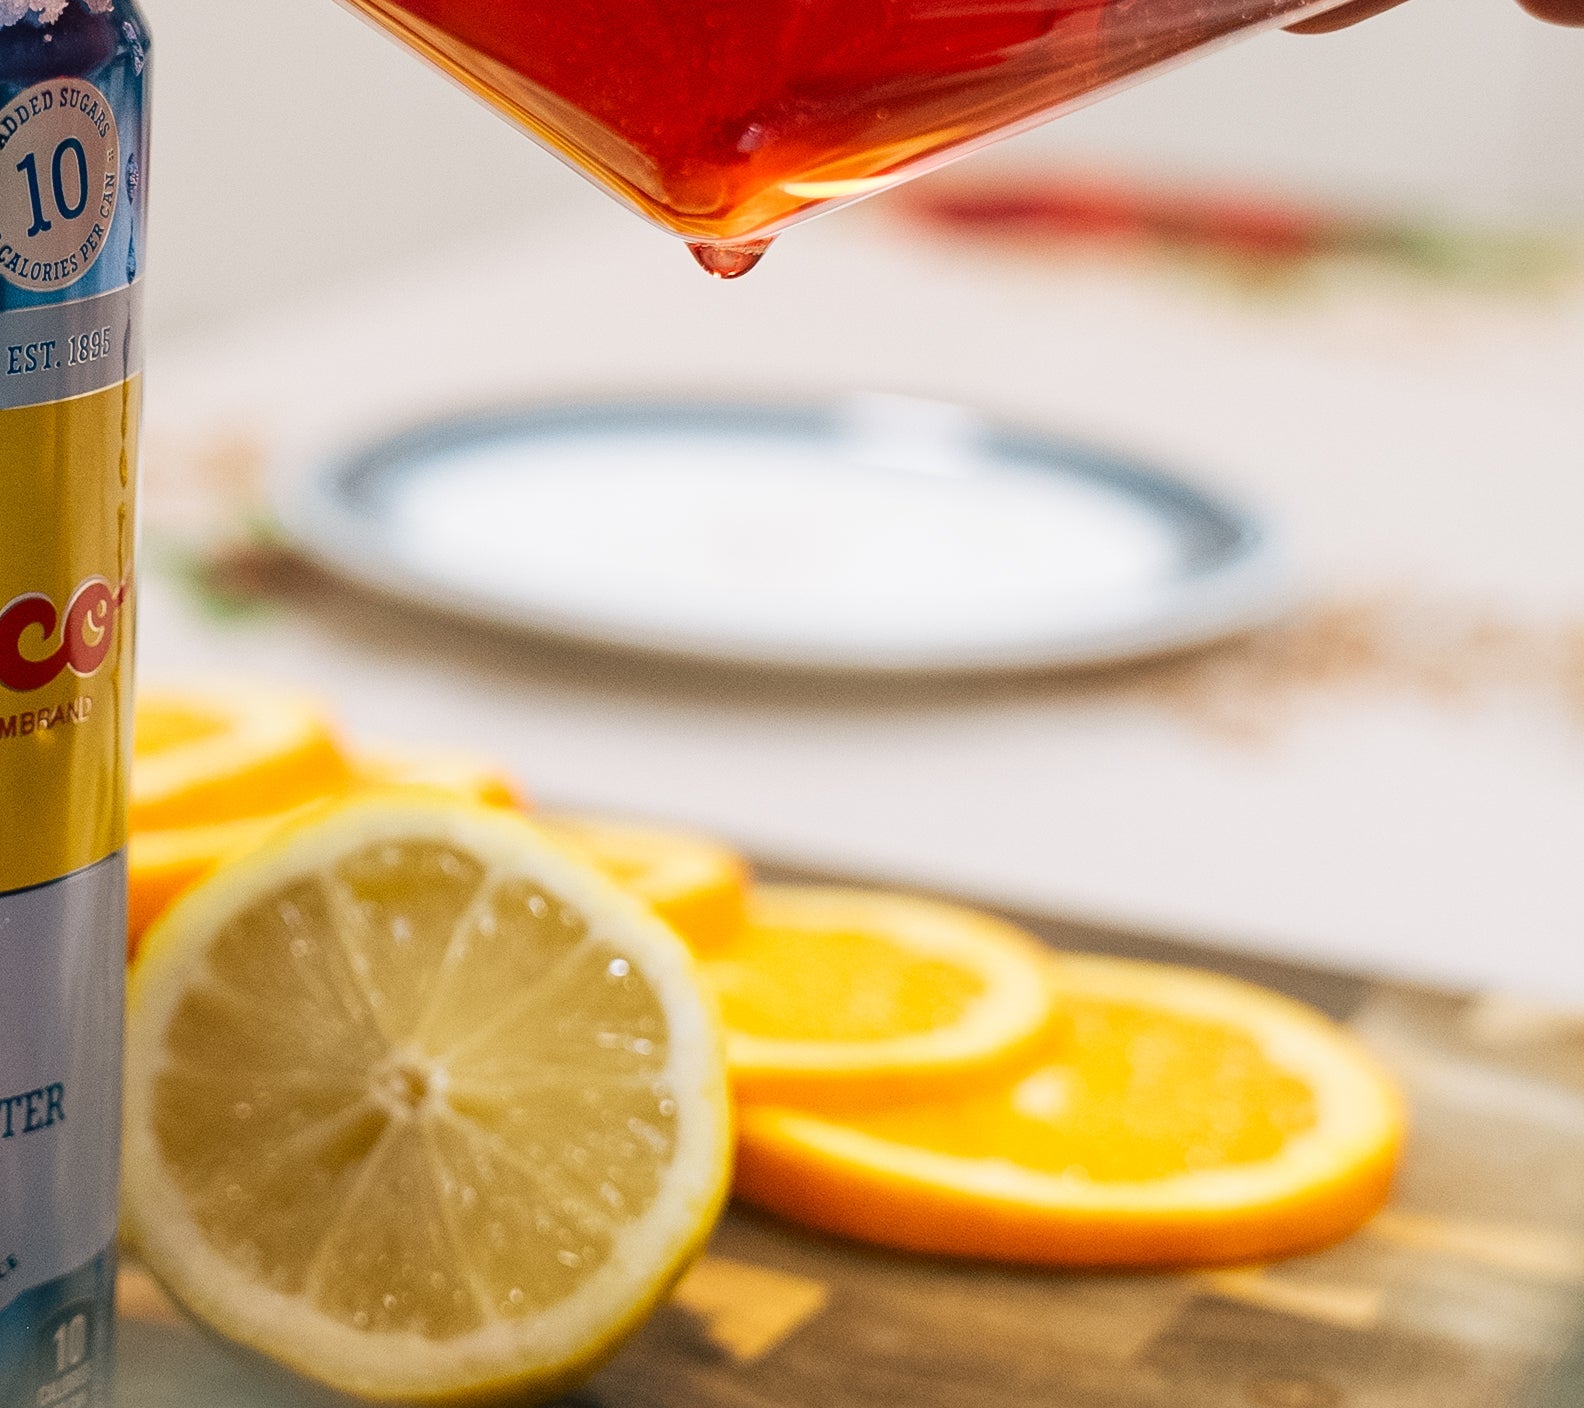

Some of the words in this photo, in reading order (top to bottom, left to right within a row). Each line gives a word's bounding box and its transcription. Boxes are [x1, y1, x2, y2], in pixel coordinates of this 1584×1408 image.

[59, 87, 110, 138] SUGARS
[16, 137, 89, 238] 10
[80, 224, 104, 263] PER
[100, 172, 116, 219] CAN
[6, 340, 61, 375] EST.
[67, 326, 111, 367] 1895
